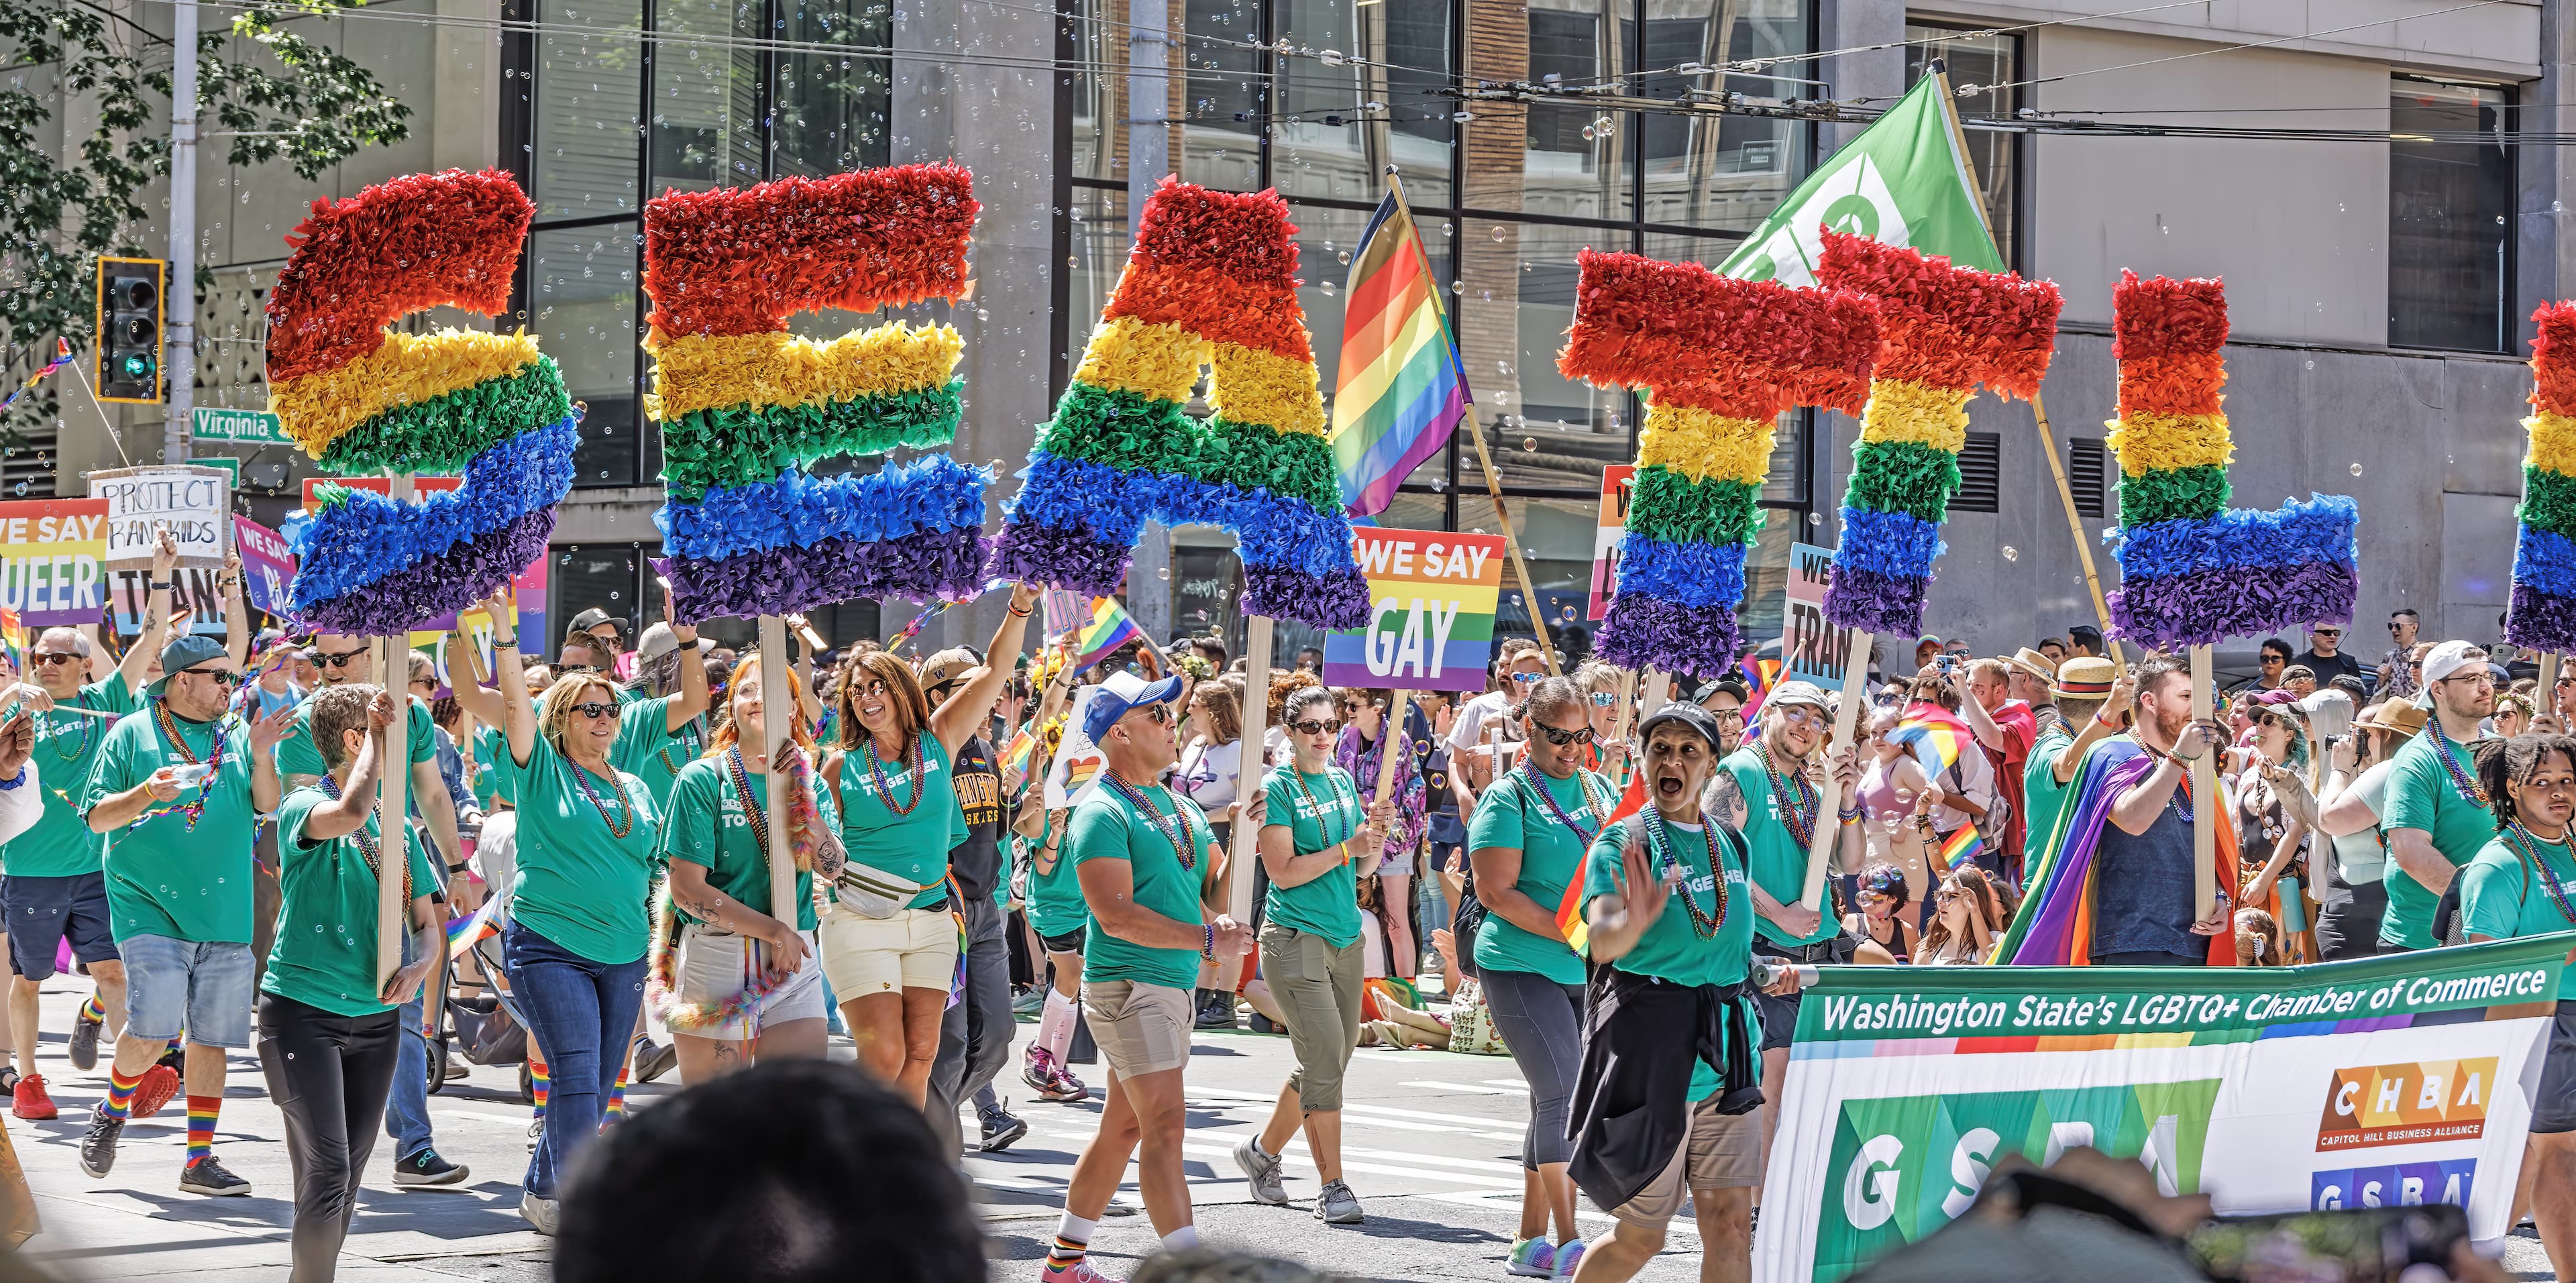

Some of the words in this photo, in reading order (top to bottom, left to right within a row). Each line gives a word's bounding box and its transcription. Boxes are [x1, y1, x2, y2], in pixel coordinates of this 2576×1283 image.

[197, 410, 268, 437] Virginia
[102, 480, 217, 512] PROTECT
[38, 514, 103, 543] SAY
[166, 520, 216, 543] KIDS
[240, 524, 265, 553] WE
[265, 537, 289, 563] SAY
[1357, 539, 1415, 575] WE
[1422, 543, 1492, 579] SAY
[1803, 552, 1830, 584] WE
[1048, 588, 1095, 636] LOVE
[1365, 596, 1460, 679] GAY
[436, 622, 494, 689] GY
[933, 667, 945, 680] W
[1823, 993, 2006, 1036] Washington
[2119, 993, 2241, 1026] LGBTQ+
[2245, 988, 2367, 1021] Chamber
[2369, 979, 2408, 1009] of
[2407, 968, 2547, 1005] Commerce
[2334, 1072, 2481, 1117] CHBA
[2320, 1134, 2361, 1146] CAPITOL
[2363, 1130, 2384, 1142] HILL
[2386, 1127, 2432, 1141] BUSINESS
[2433, 1124, 2480, 1137] ALLIANCE
